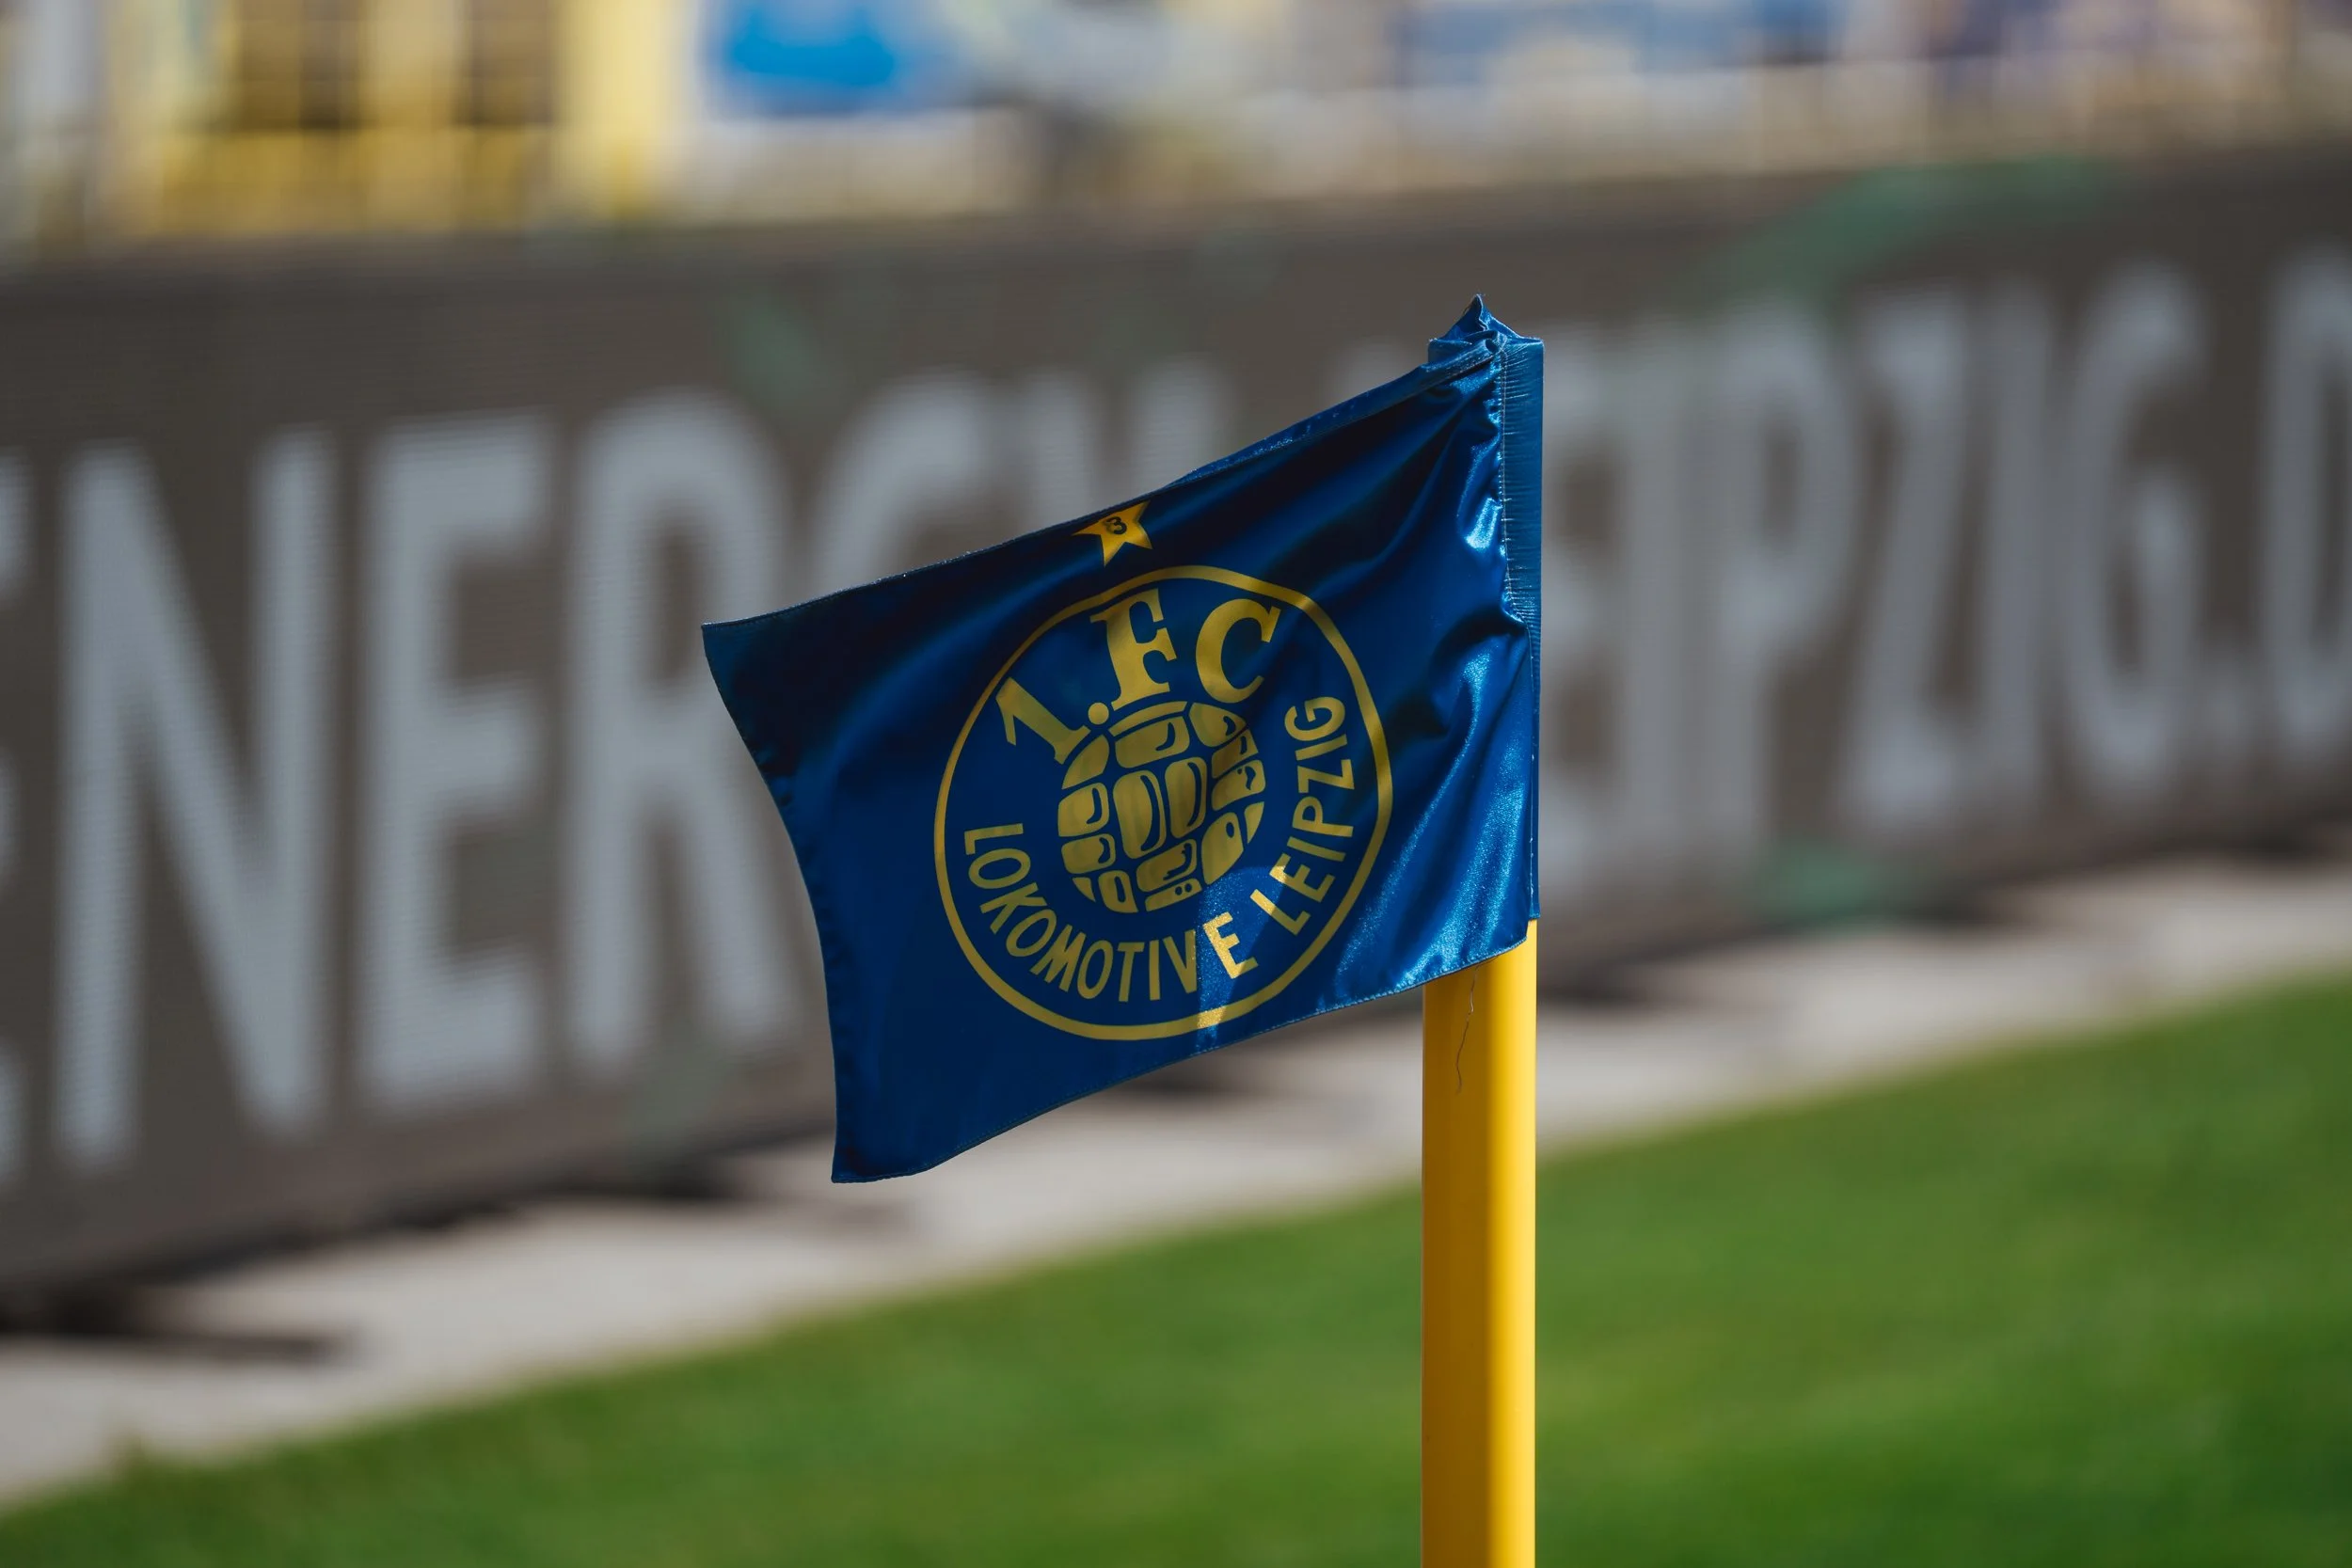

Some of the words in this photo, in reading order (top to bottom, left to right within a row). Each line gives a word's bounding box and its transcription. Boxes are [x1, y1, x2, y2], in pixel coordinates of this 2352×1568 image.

[1105, 516, 1127, 534] 3
[964, 823, 1259, 1002] LOKOMOTIVE
[1250, 696, 1355, 936] LEIPZIG
